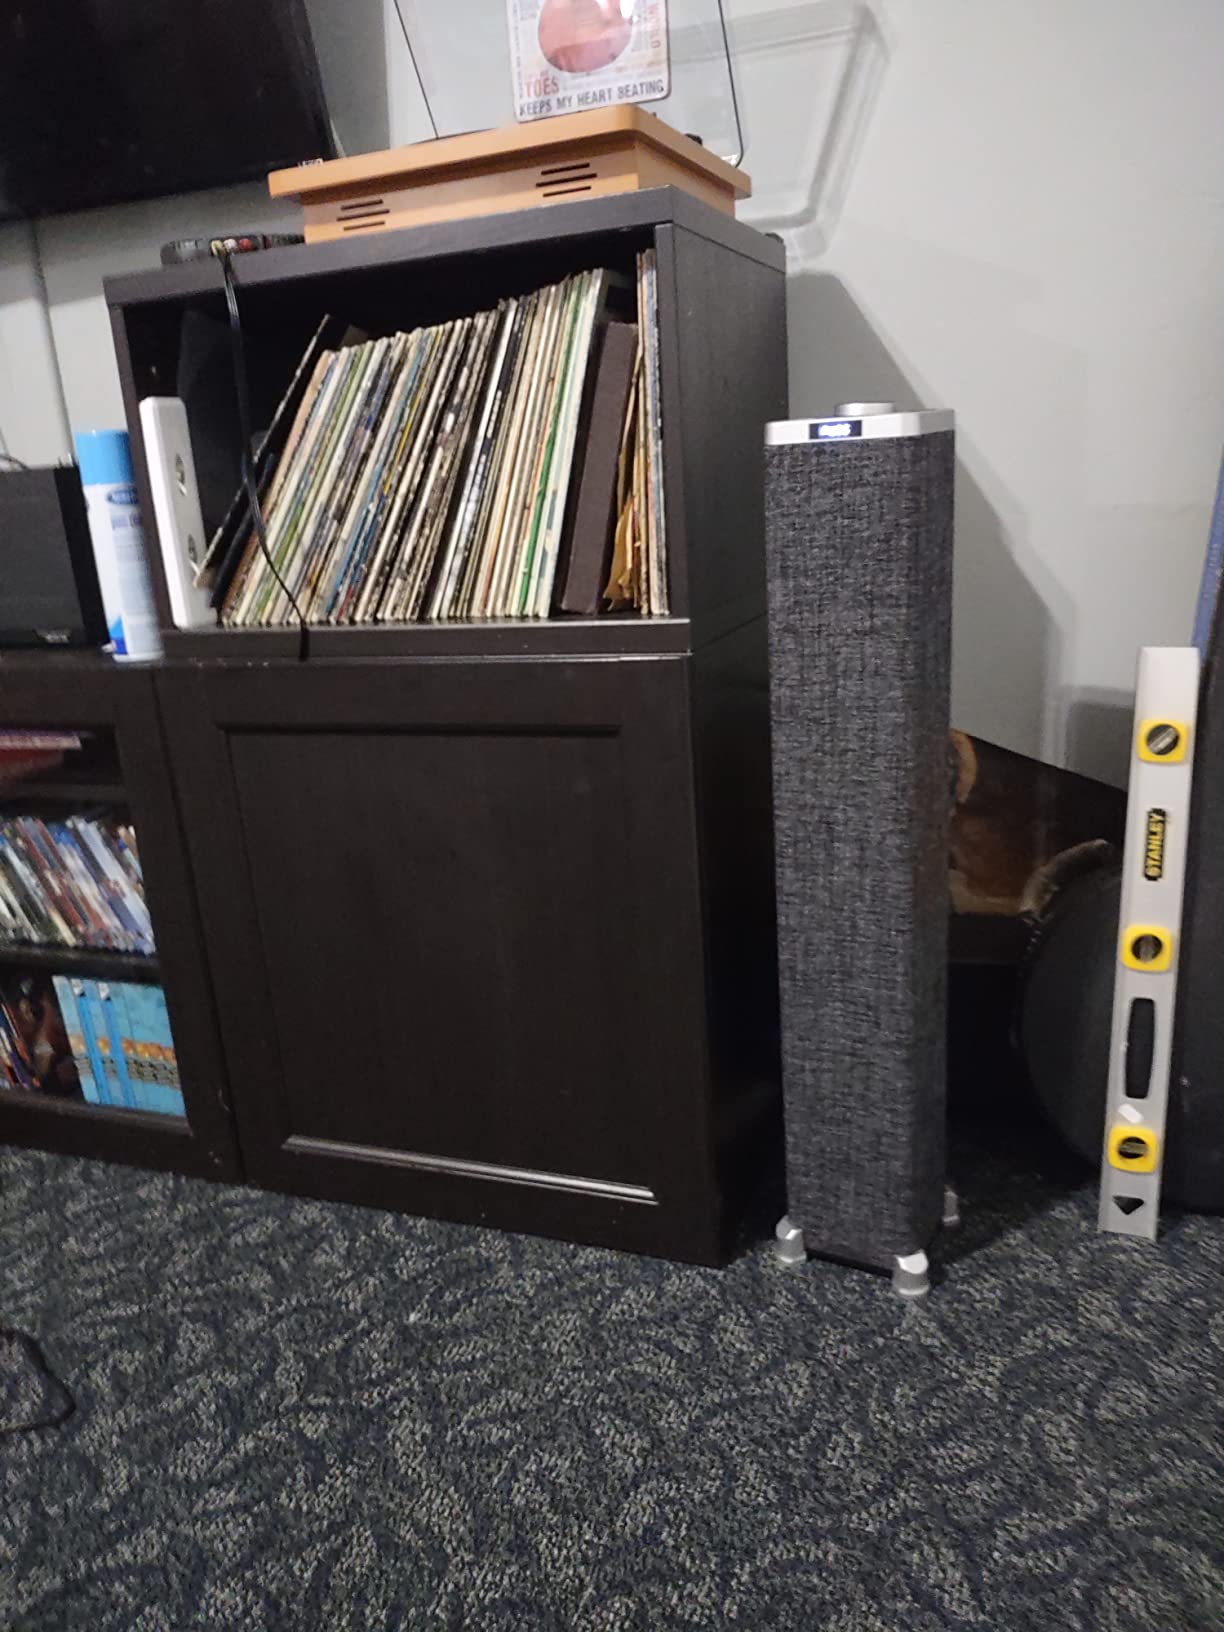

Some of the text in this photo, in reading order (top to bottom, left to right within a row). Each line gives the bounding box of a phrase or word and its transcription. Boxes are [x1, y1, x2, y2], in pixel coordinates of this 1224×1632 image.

[519, 97, 553, 116] KEEPS
[556, 93, 573, 108] MY
[577, 87, 613, 105] HEART
[617, 79, 664, 99] BEATING
[526, 75, 560, 98] TOES
[1144, 813, 1164, 877] STANLEY
